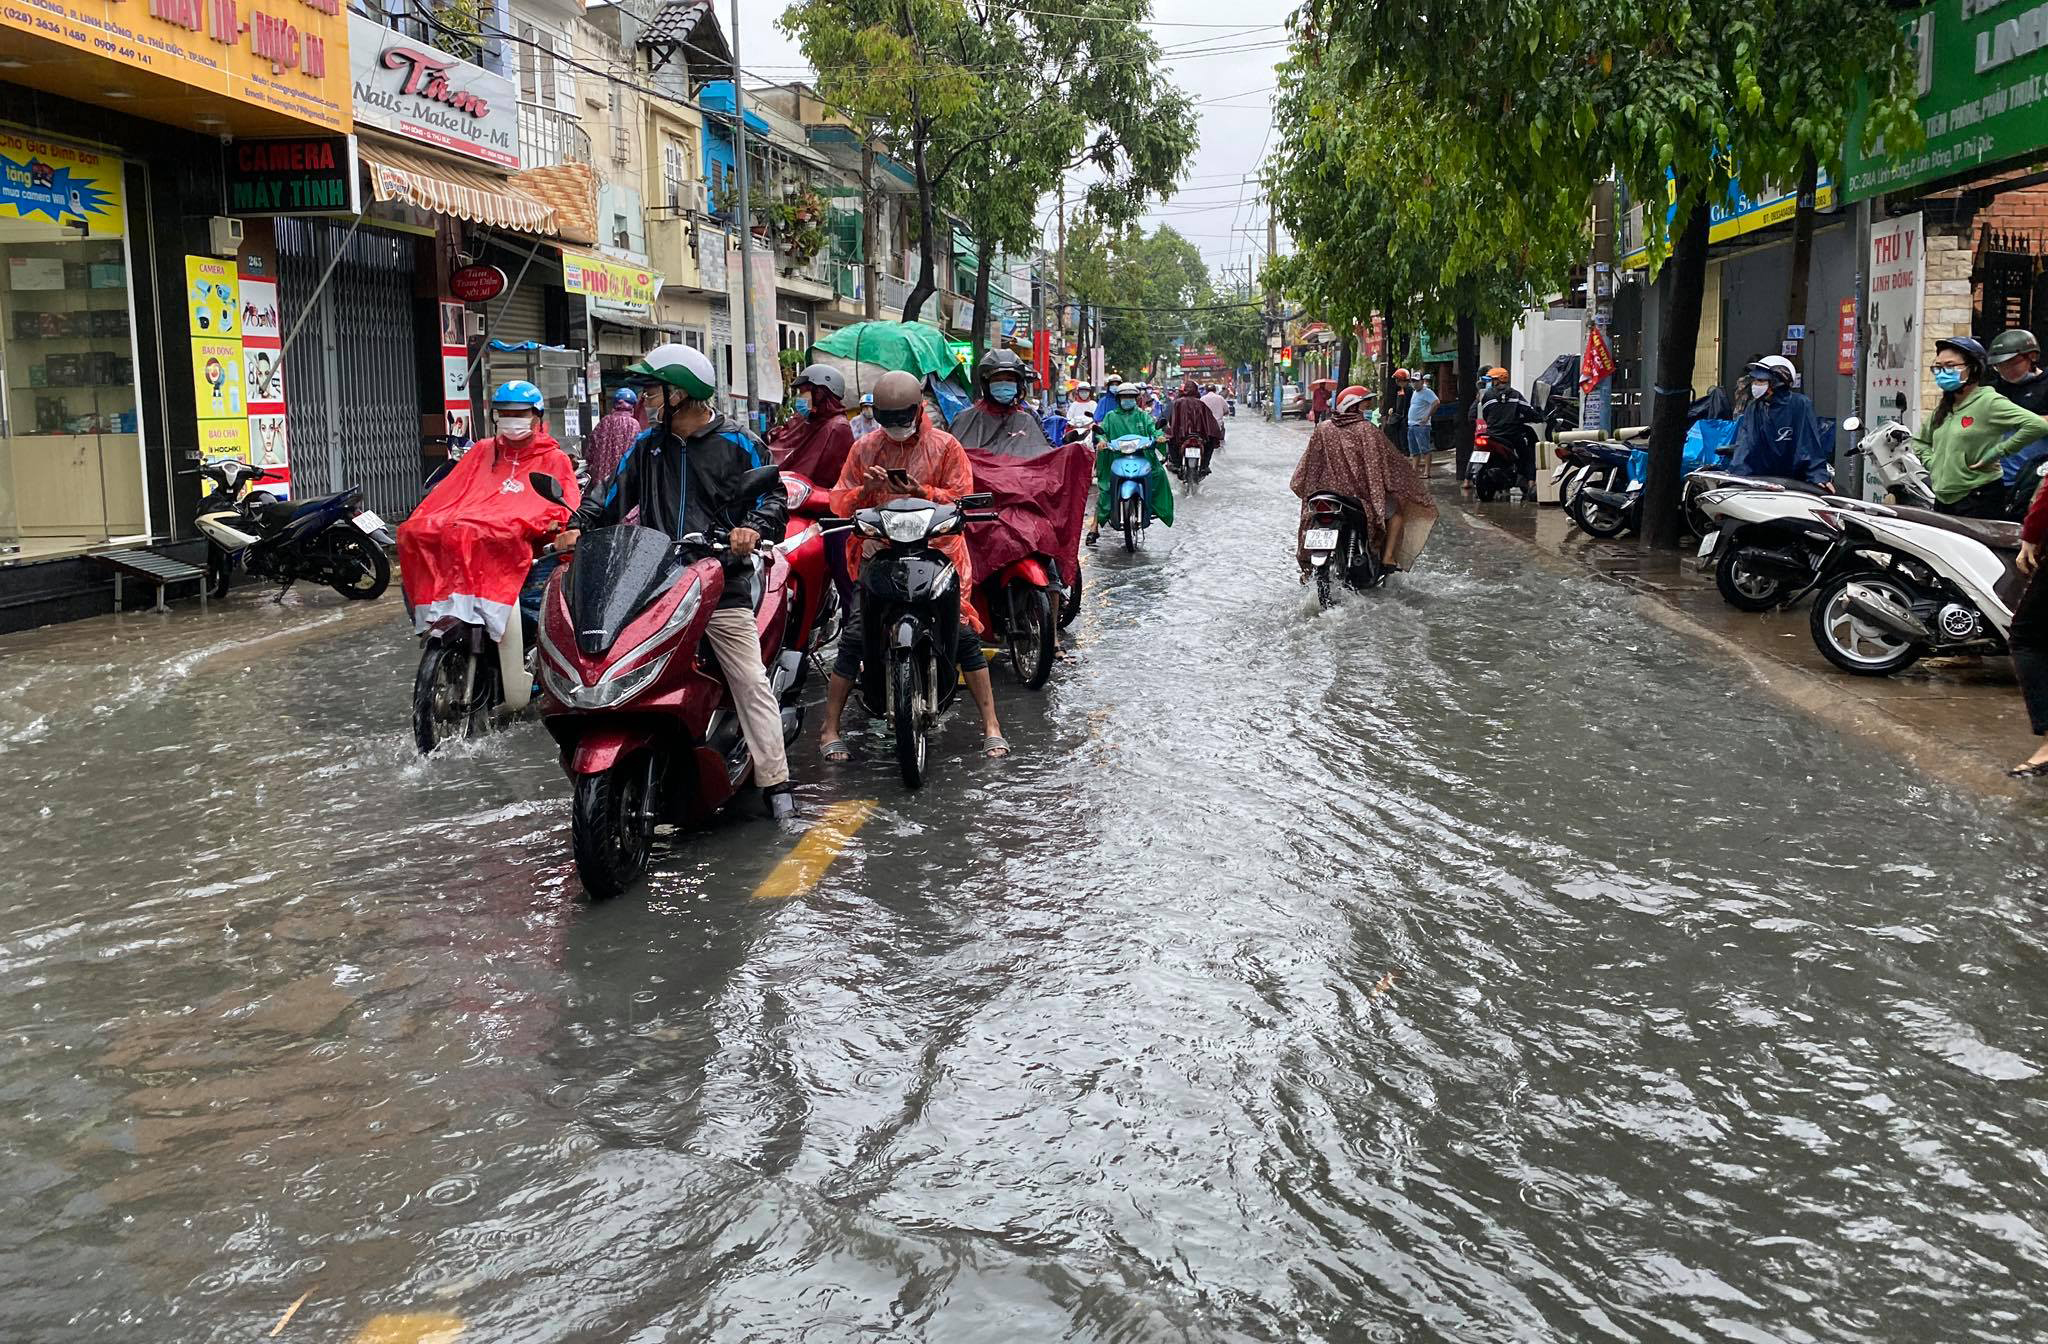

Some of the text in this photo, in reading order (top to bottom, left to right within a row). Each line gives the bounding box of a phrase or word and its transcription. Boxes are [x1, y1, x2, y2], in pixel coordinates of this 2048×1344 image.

[4, 7, 32, 25] (028)
[35, 18, 60, 33] 3636
[94, 38, 117, 53] 0909
[119, 46, 135, 59] 449
[137, 52, 152, 65] 141
[353, 81, 401, 114] Nails
[239, 143, 336, 172] CAMERA
[232, 174, 344, 209] MÁY TÍNH
[1874, 224, 1915, 265] THÚ Y
[199, 263, 225, 275] CAMERA
[1873, 268, 1914, 293] LINH ĐÔNG
